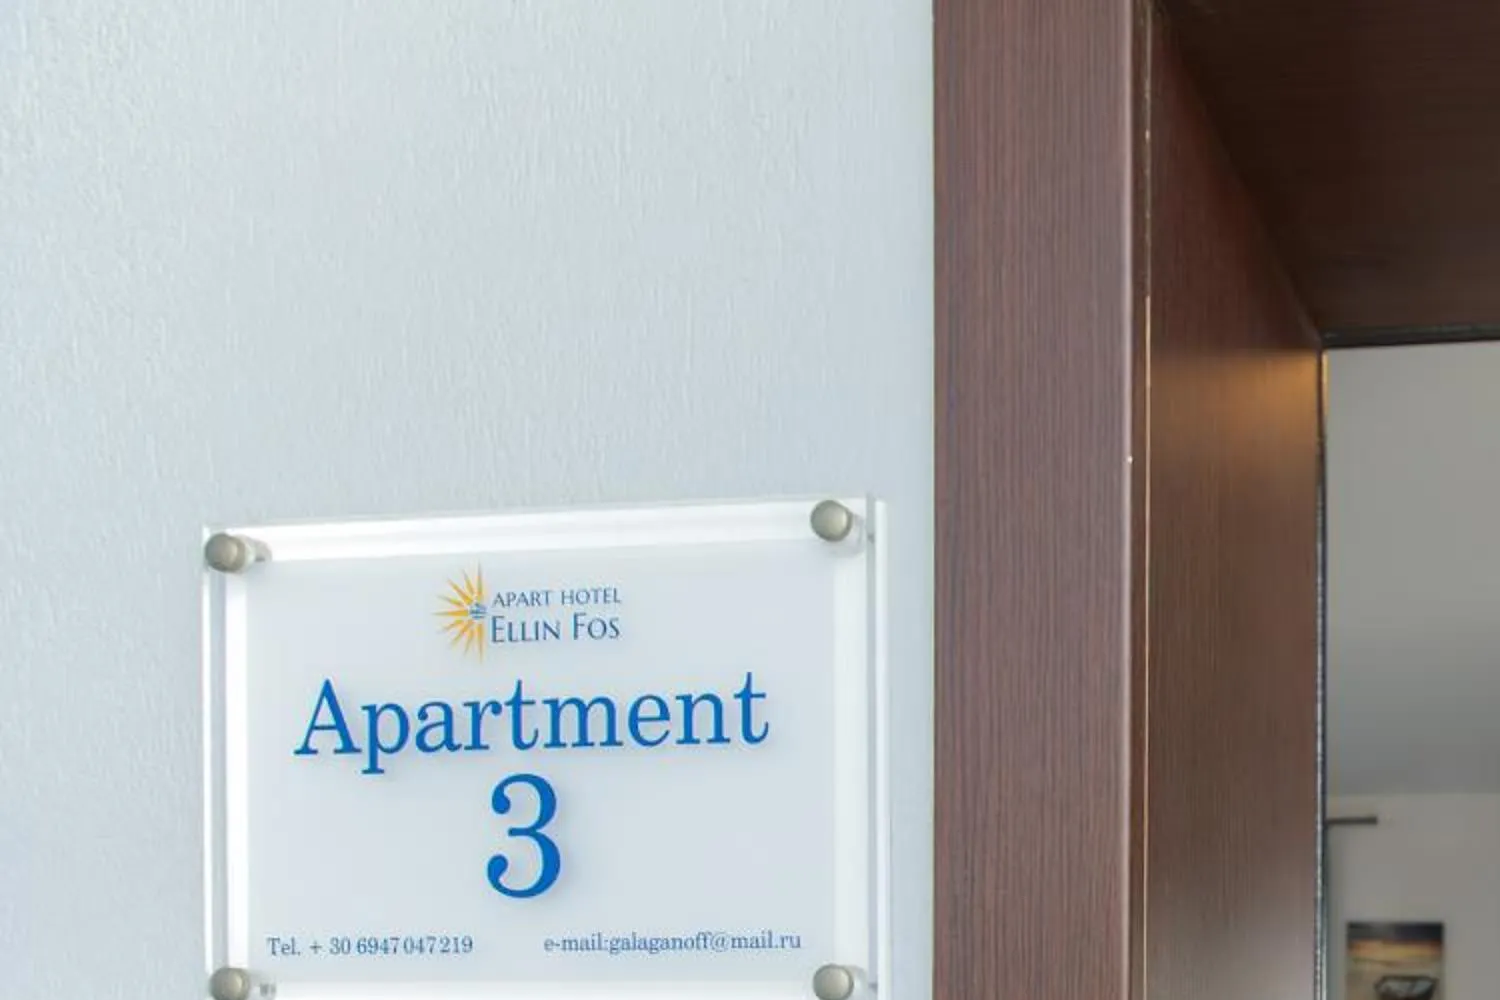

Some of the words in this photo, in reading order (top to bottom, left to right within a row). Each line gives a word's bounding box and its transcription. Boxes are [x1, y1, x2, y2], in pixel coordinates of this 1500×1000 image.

[491, 589, 554, 608] APART
[560, 587, 622, 606] HOTEL
[293, 671, 769, 776] Apartment
[485, 772, 562, 900] 3
[266, 936, 302, 957] Tel.
[329, 936, 352, 956] 30
